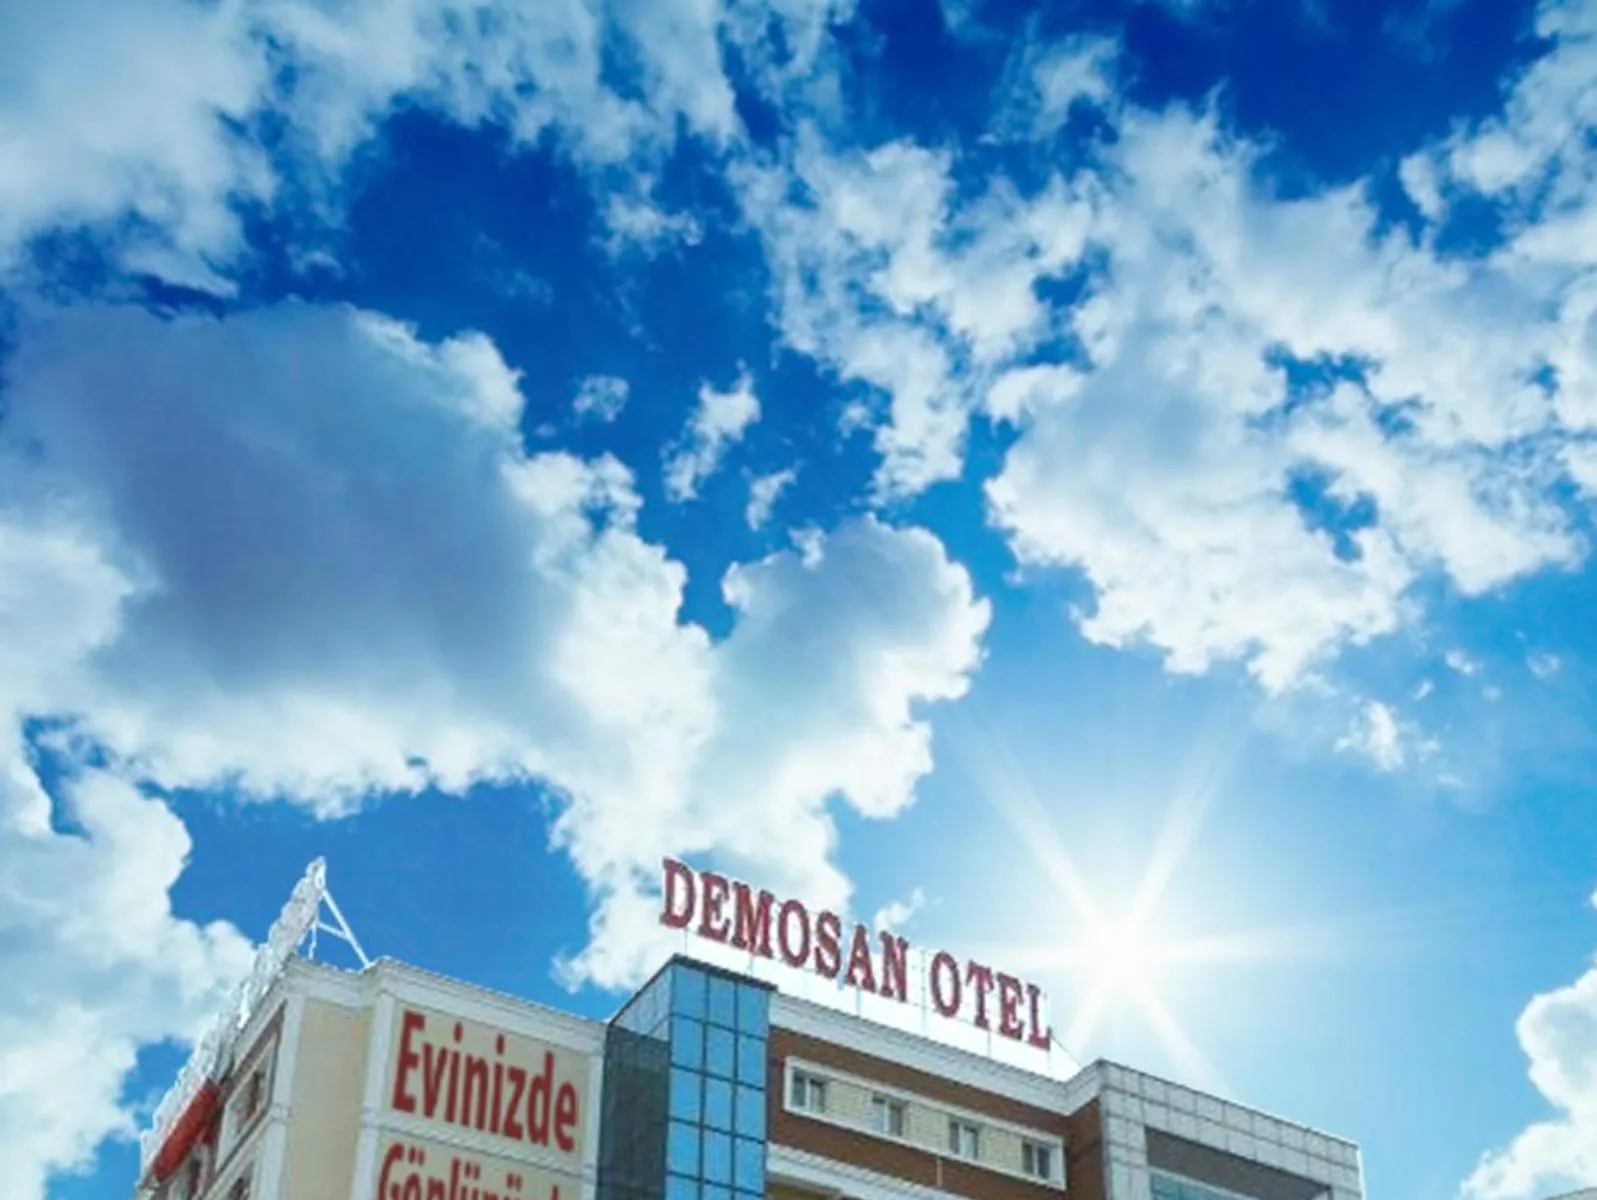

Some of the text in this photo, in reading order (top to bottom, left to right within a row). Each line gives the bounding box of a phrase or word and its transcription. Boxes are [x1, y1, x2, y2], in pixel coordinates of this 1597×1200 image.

[660, 857, 1052, 1051] DEMOSAN OTEL
[392, 1010, 577, 1153] Evinizde
